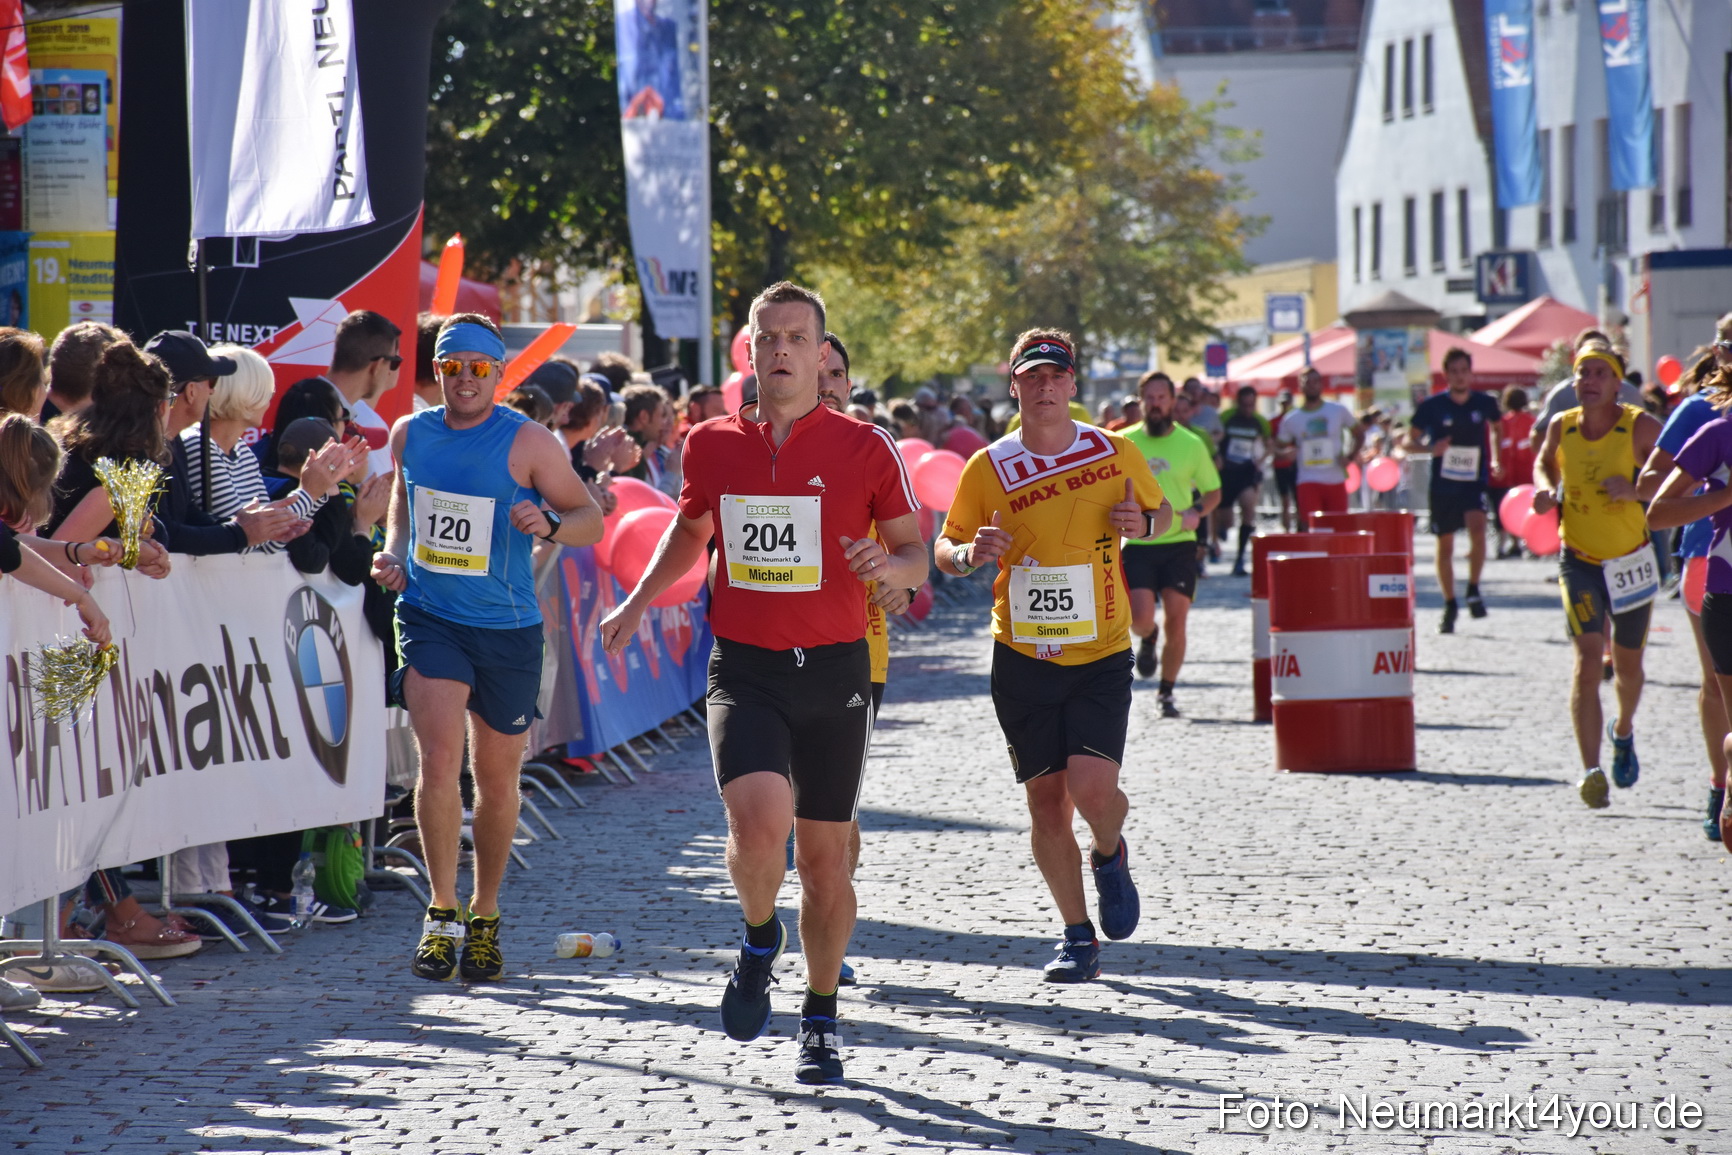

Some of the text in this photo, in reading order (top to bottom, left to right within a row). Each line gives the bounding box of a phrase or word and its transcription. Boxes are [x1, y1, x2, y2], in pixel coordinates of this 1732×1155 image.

[33, 257, 67, 284] 19.
[185, 321, 279, 344] TE NEXT
[1008, 463, 1122, 514] MAX BÖGL
[432, 498, 469, 512] BOCK
[746, 505, 791, 515] BOCK
[428, 513, 471, 543] 120
[742, 523, 797, 552] 204
[742, 555, 760, 563] PARTL
[748, 568, 793, 582] Michael
[1031, 573, 1068, 582] BOCK
[1614, 562, 1653, 589] 3119
[1027, 588, 1074, 612] 255
[285, 590, 344, 656] BMW
[1037, 625, 1069, 636] Simon
